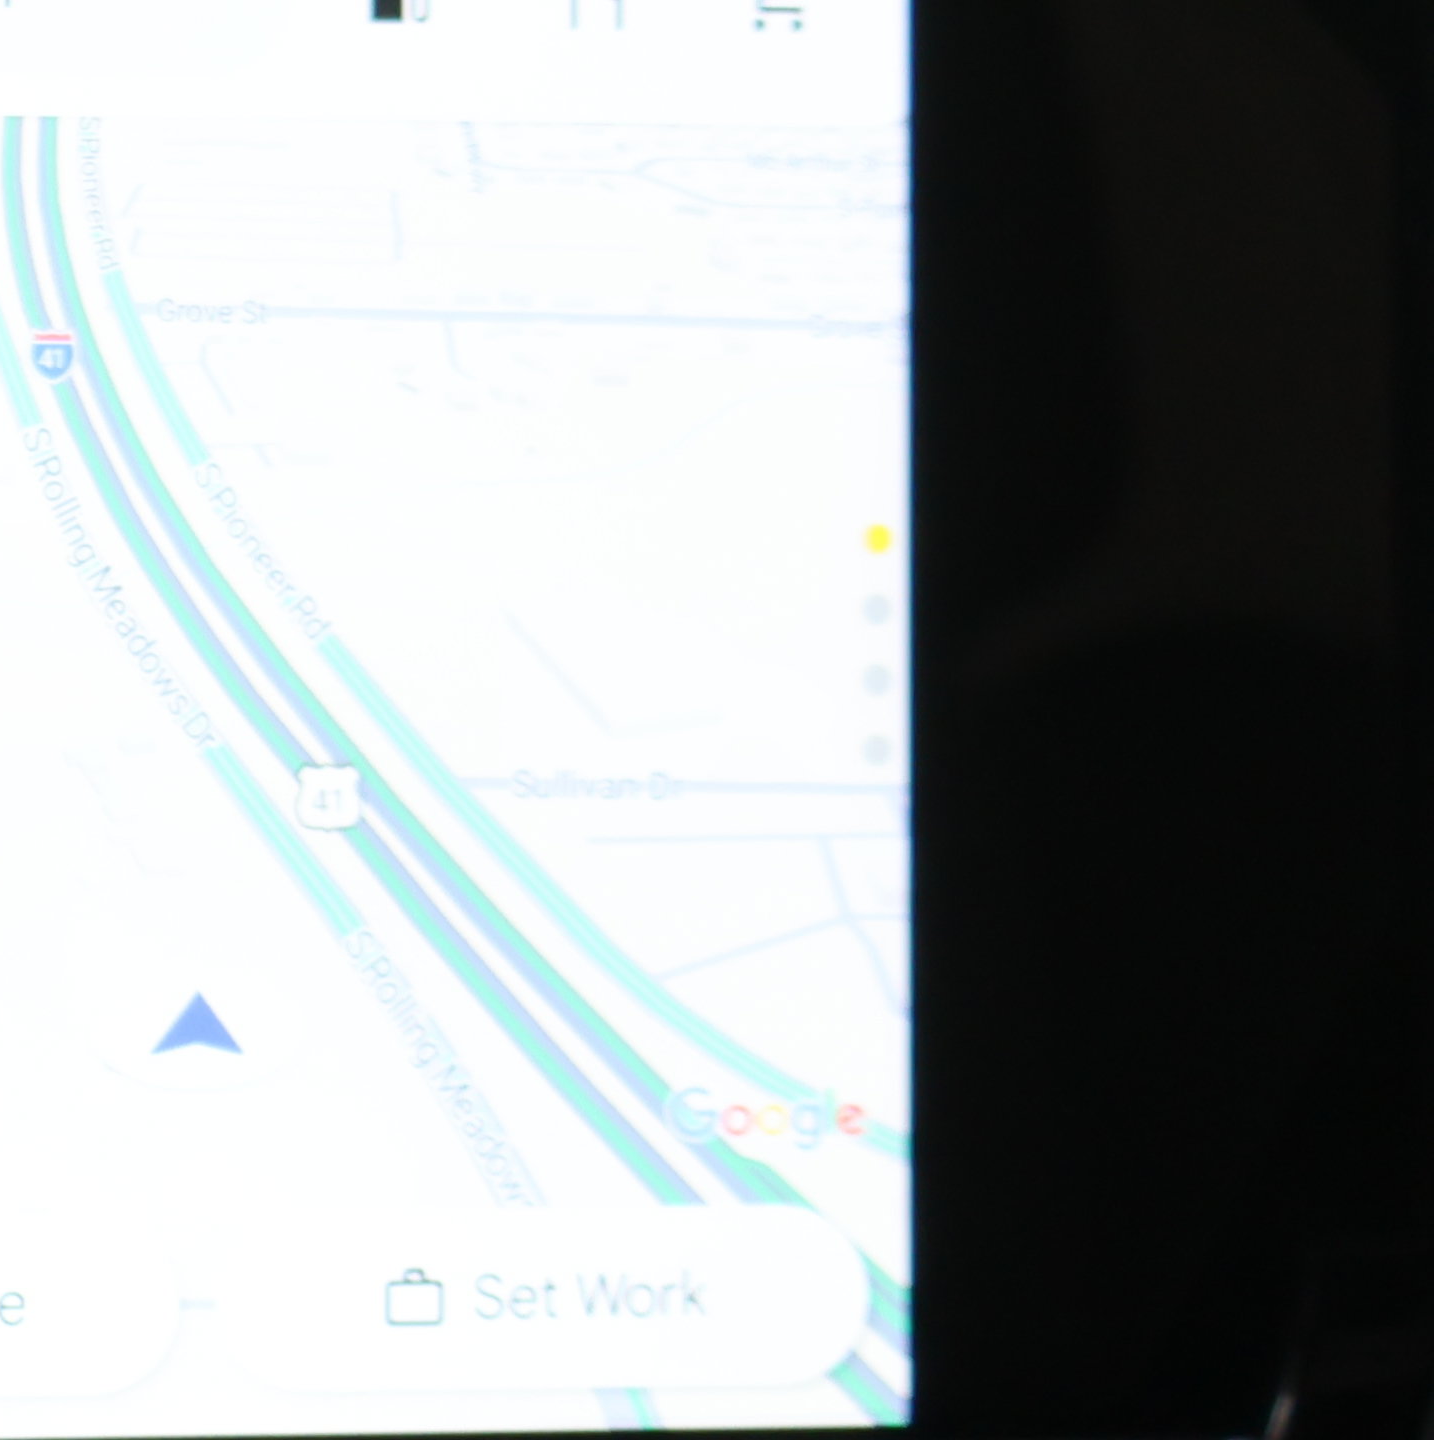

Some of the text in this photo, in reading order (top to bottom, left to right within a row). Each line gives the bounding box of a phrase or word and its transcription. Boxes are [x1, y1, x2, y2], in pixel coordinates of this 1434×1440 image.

[158, 298, 233, 323] Grove
[209, 486, 298, 597] Pioneer
[35, 456, 97, 567] Rolling
[87, 565, 189, 716] Meadows
[669, 1087, 867, 1150] Google
[475, 1270, 707, 1320] Set Work
